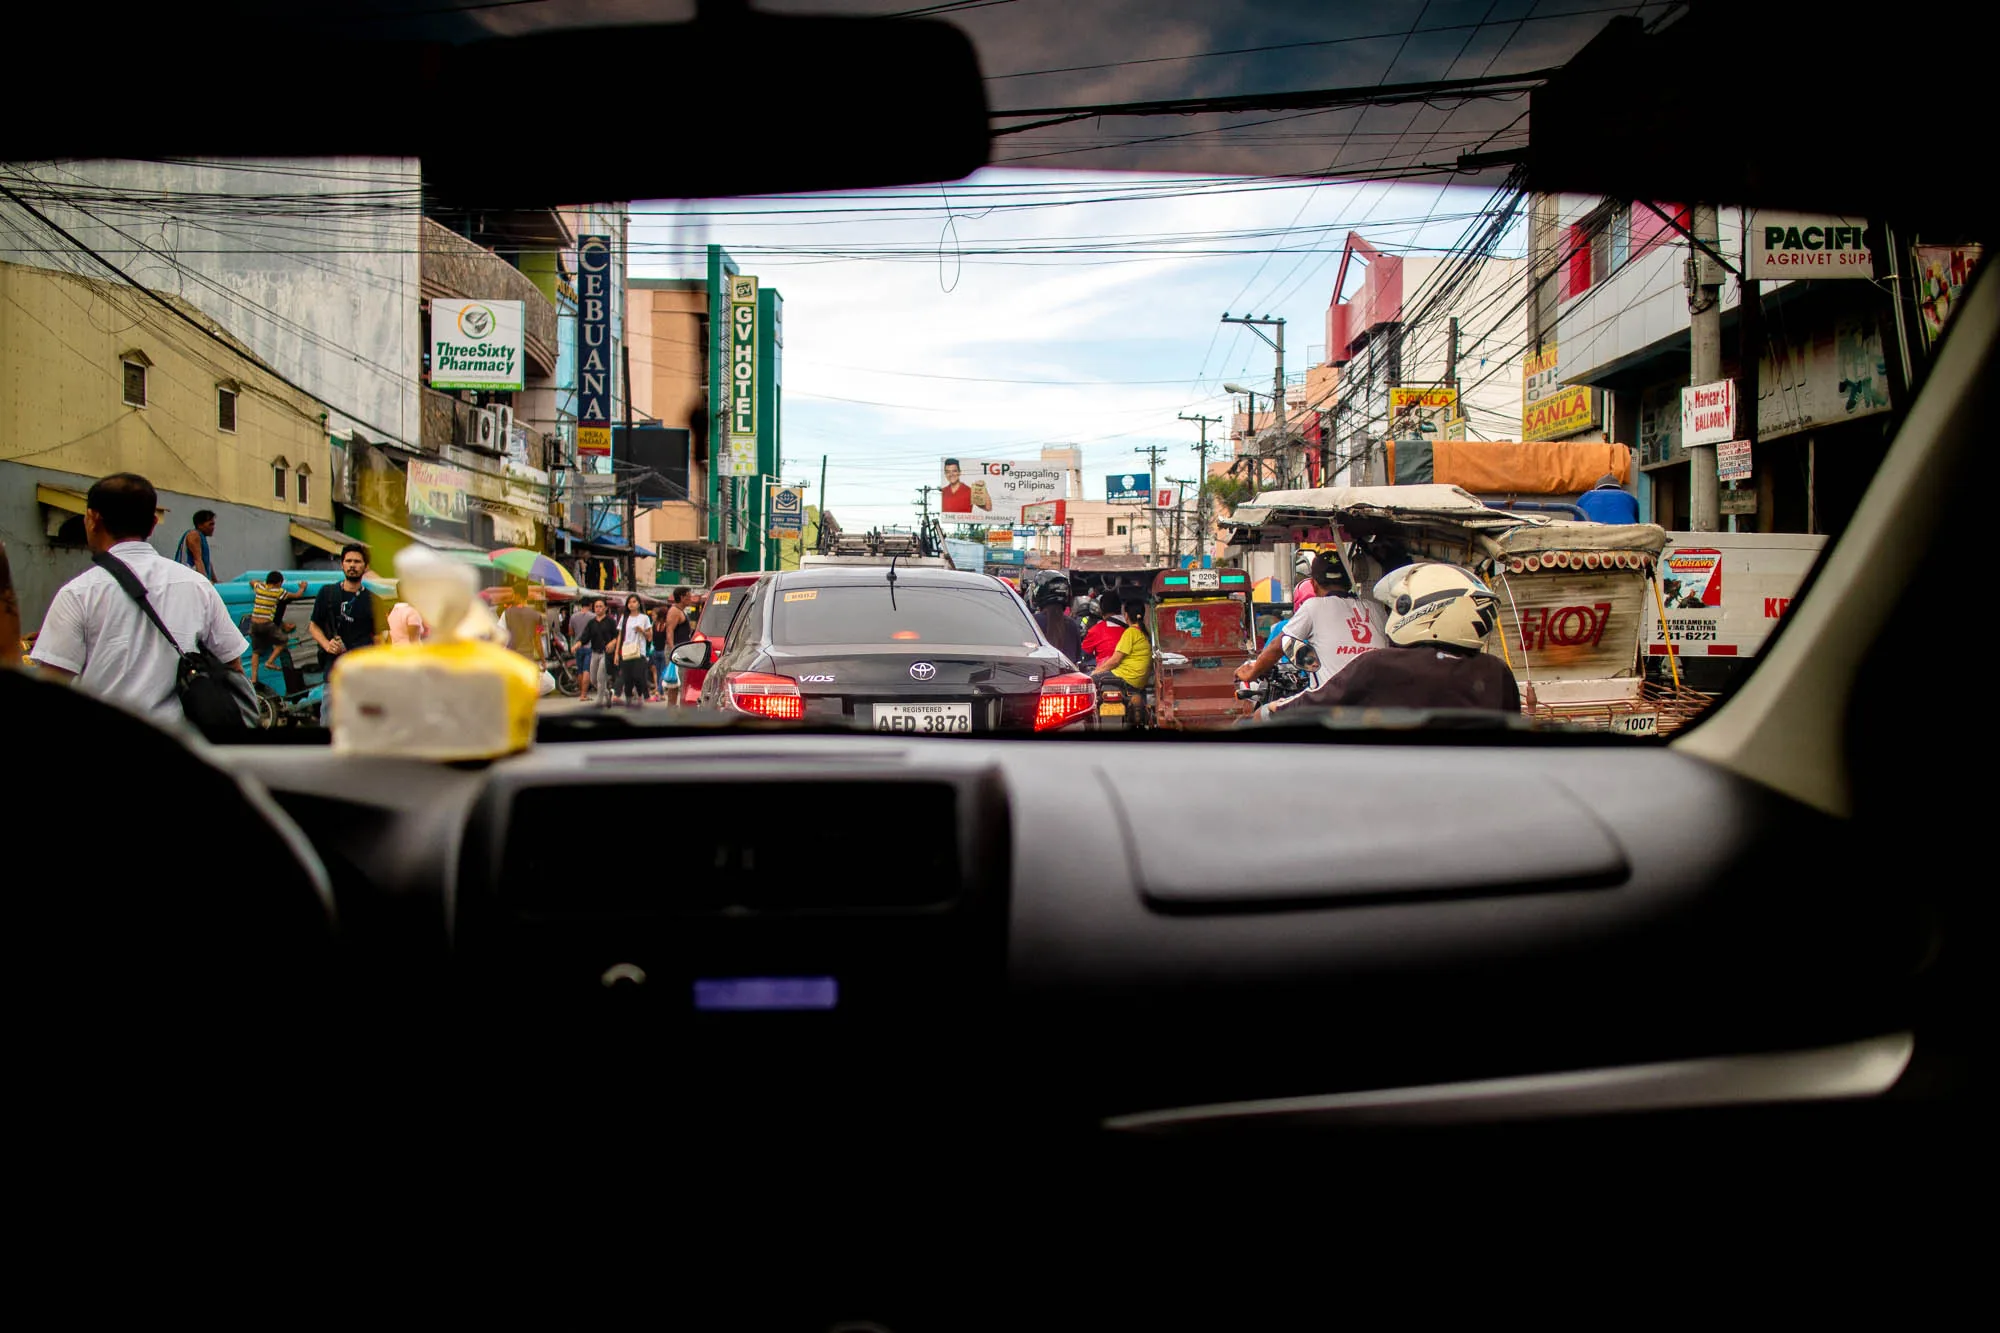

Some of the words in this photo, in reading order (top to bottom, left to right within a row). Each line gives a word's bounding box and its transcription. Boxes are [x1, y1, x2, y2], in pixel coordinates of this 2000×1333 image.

[1765, 226, 1869, 250] PACIFI
[1766, 253, 1832, 265] AGRIVET
[579, 236, 608, 420] CEBUANA
[735, 306, 753, 341] GV
[436, 342, 516, 361] ThreeSixty
[438, 356, 515, 375] Pharmacy
[734, 344, 752, 433] HOTEL
[1694, 388, 1725, 408] Maricar's
[1397, 394, 1449, 406] SANLA
[1525, 393, 1587, 432] SANLA
[1695, 411, 1725, 432] BALLOONS
[1004, 482, 1016, 491] ng
[1018, 480, 1056, 491] Pilipinas
[1669, 558, 1715, 567] WARHAWK
[878, 715, 917, 731] AED
[923, 715, 969, 732] 3878
[1624, 718, 1655, 731] 1007
